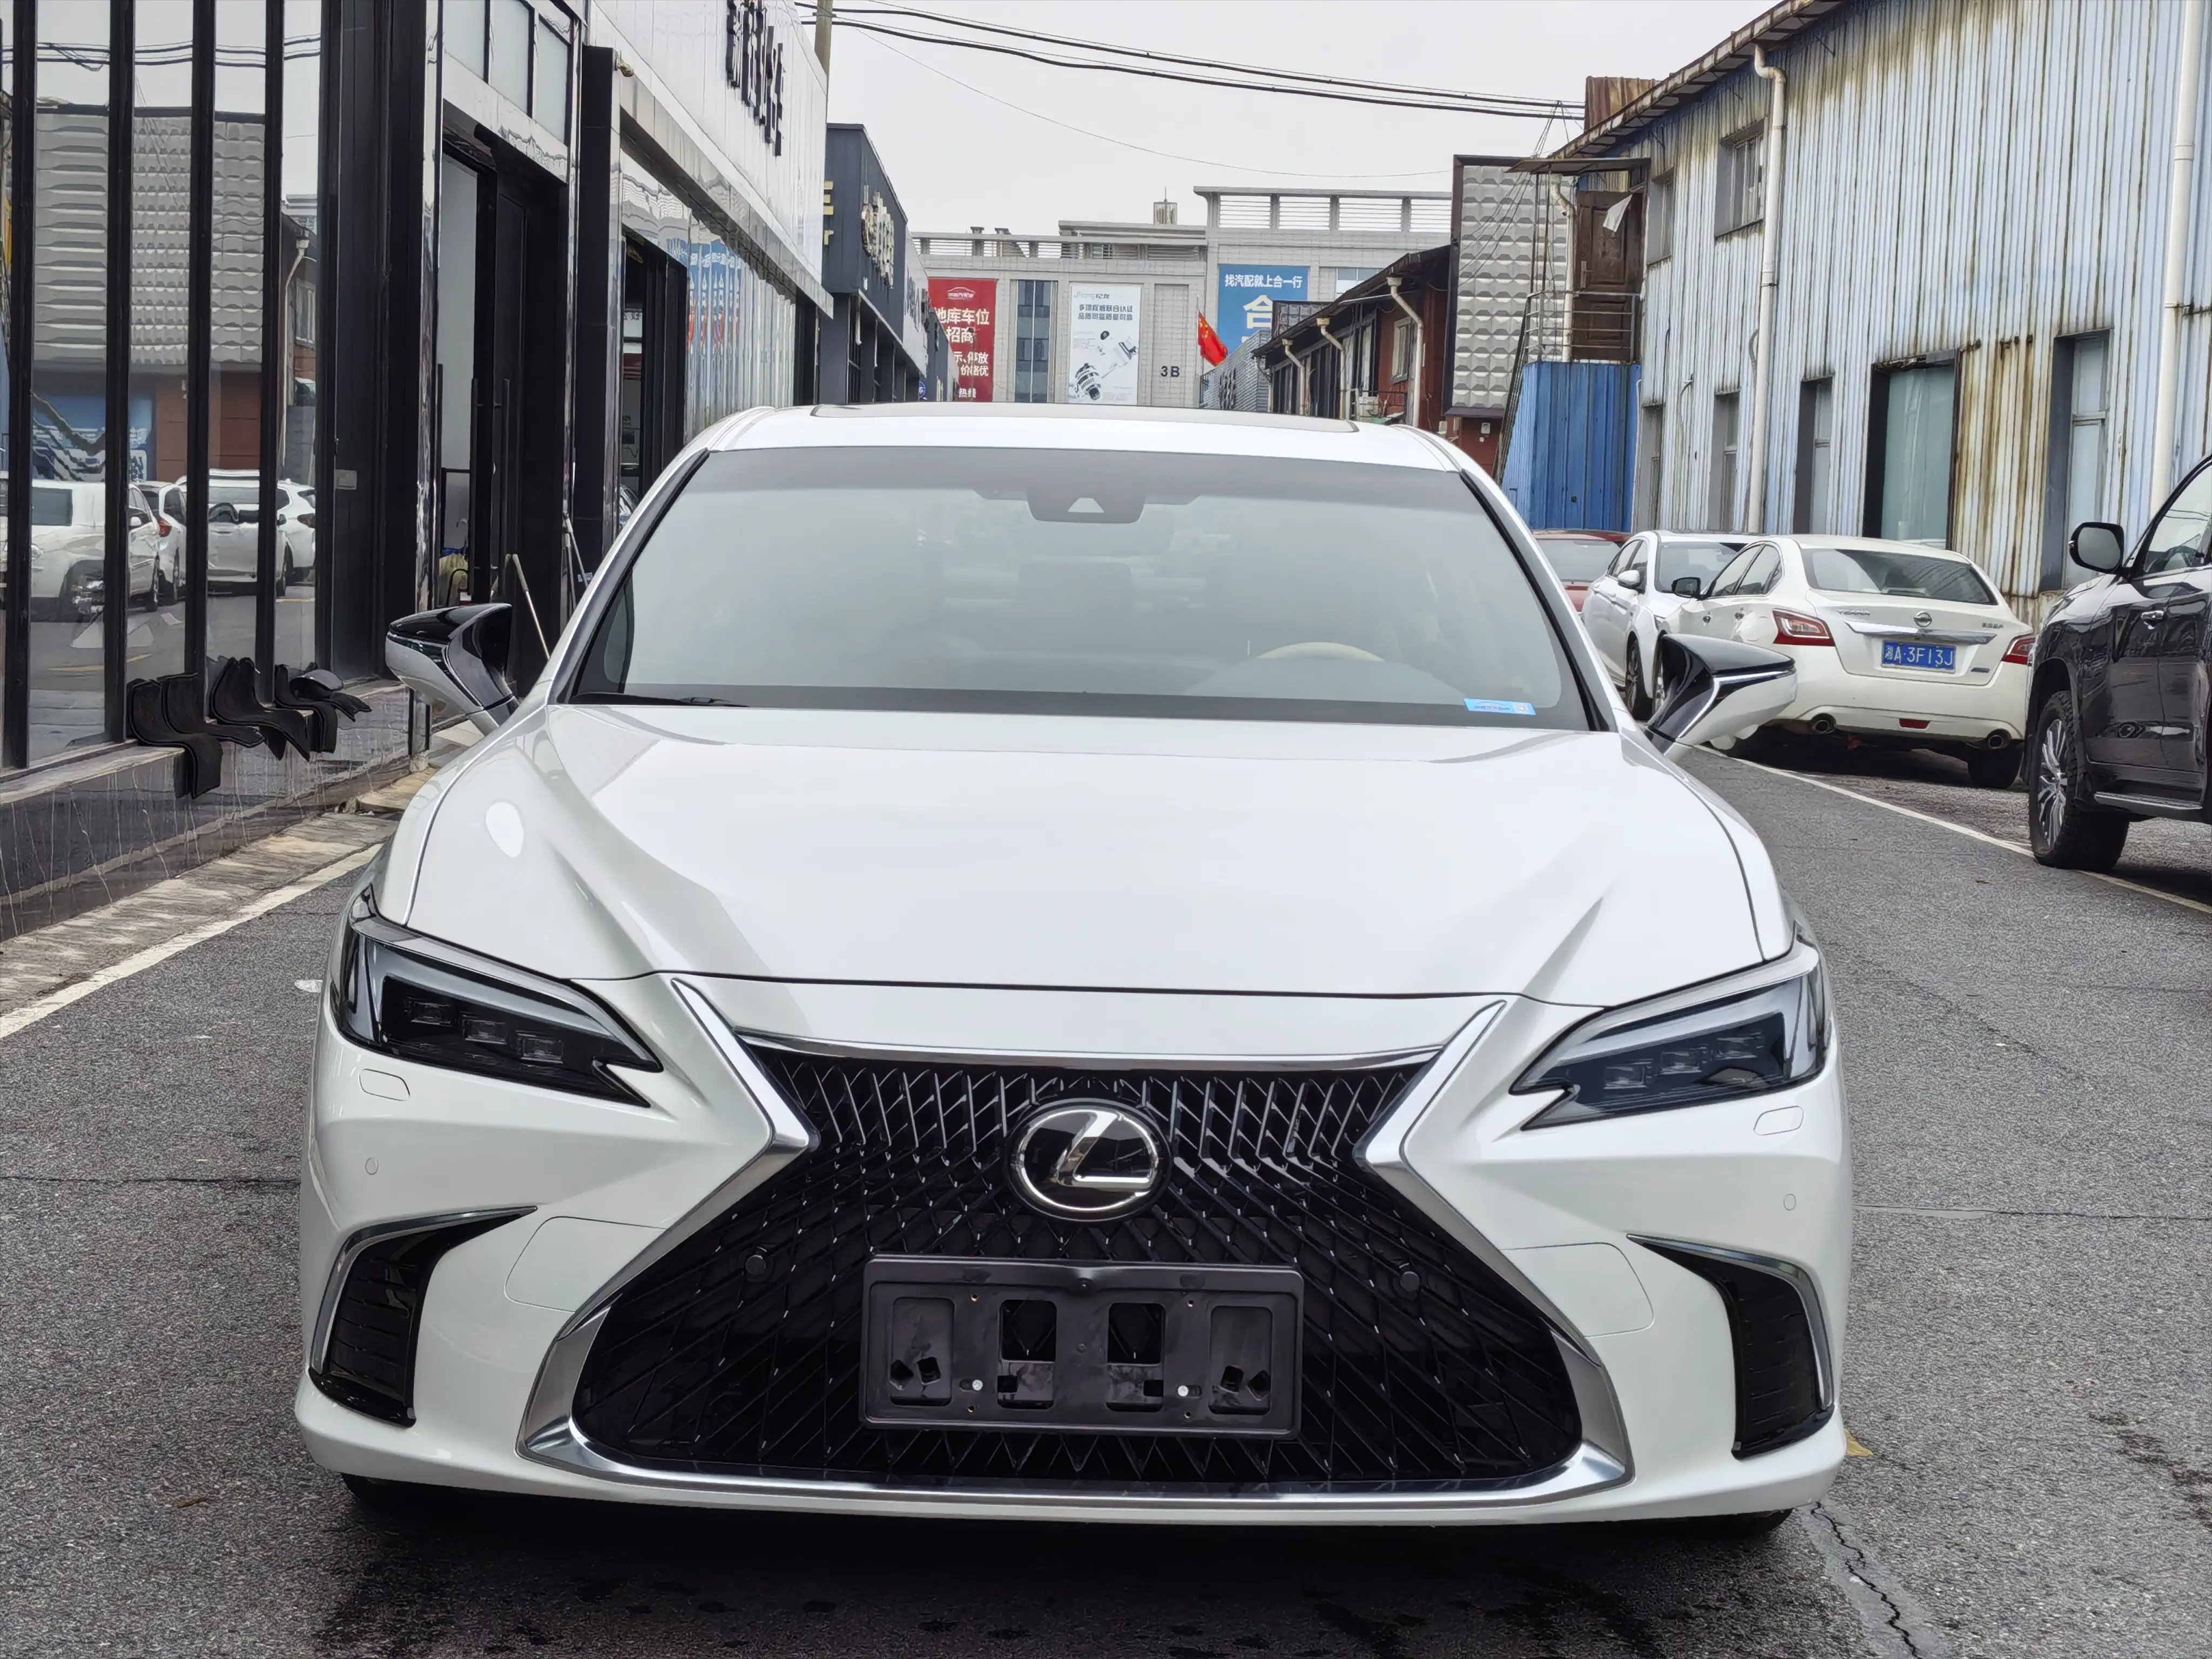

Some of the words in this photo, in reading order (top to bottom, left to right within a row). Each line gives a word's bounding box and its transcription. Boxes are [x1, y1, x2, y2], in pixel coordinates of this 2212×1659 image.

[1225, 274, 1303, 288] 找汽配就上合一行
[933, 306, 990, 325] 地库车位
[945, 326, 974, 343] 招商
[960, 365, 989, 376] 价格优
[1161, 365, 1180, 377] 3B
